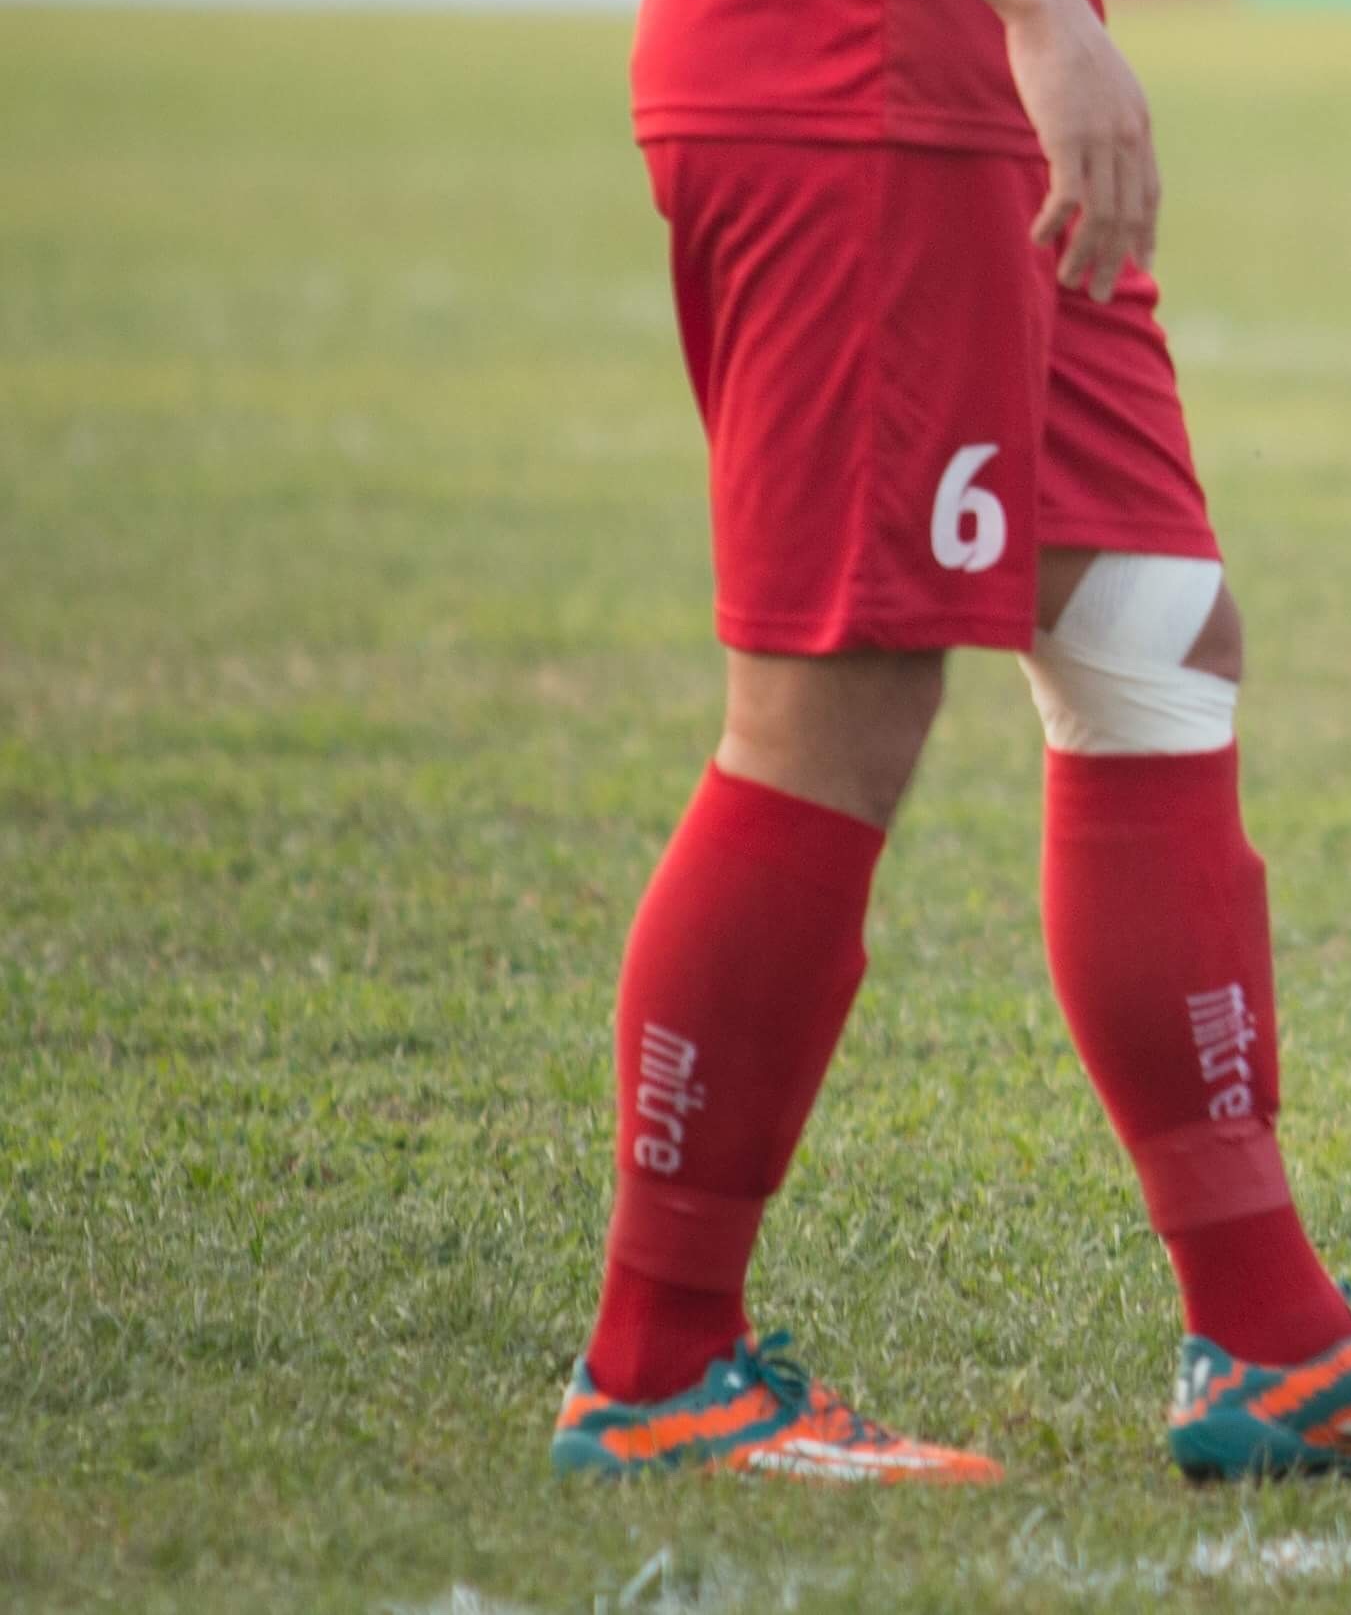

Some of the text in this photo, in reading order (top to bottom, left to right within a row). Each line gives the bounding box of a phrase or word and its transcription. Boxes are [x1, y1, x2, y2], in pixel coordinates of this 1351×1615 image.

[930, 443, 1007, 572] 6
[633, 1022, 704, 1176] mitre
[1186, 982, 1257, 1121] mitre
